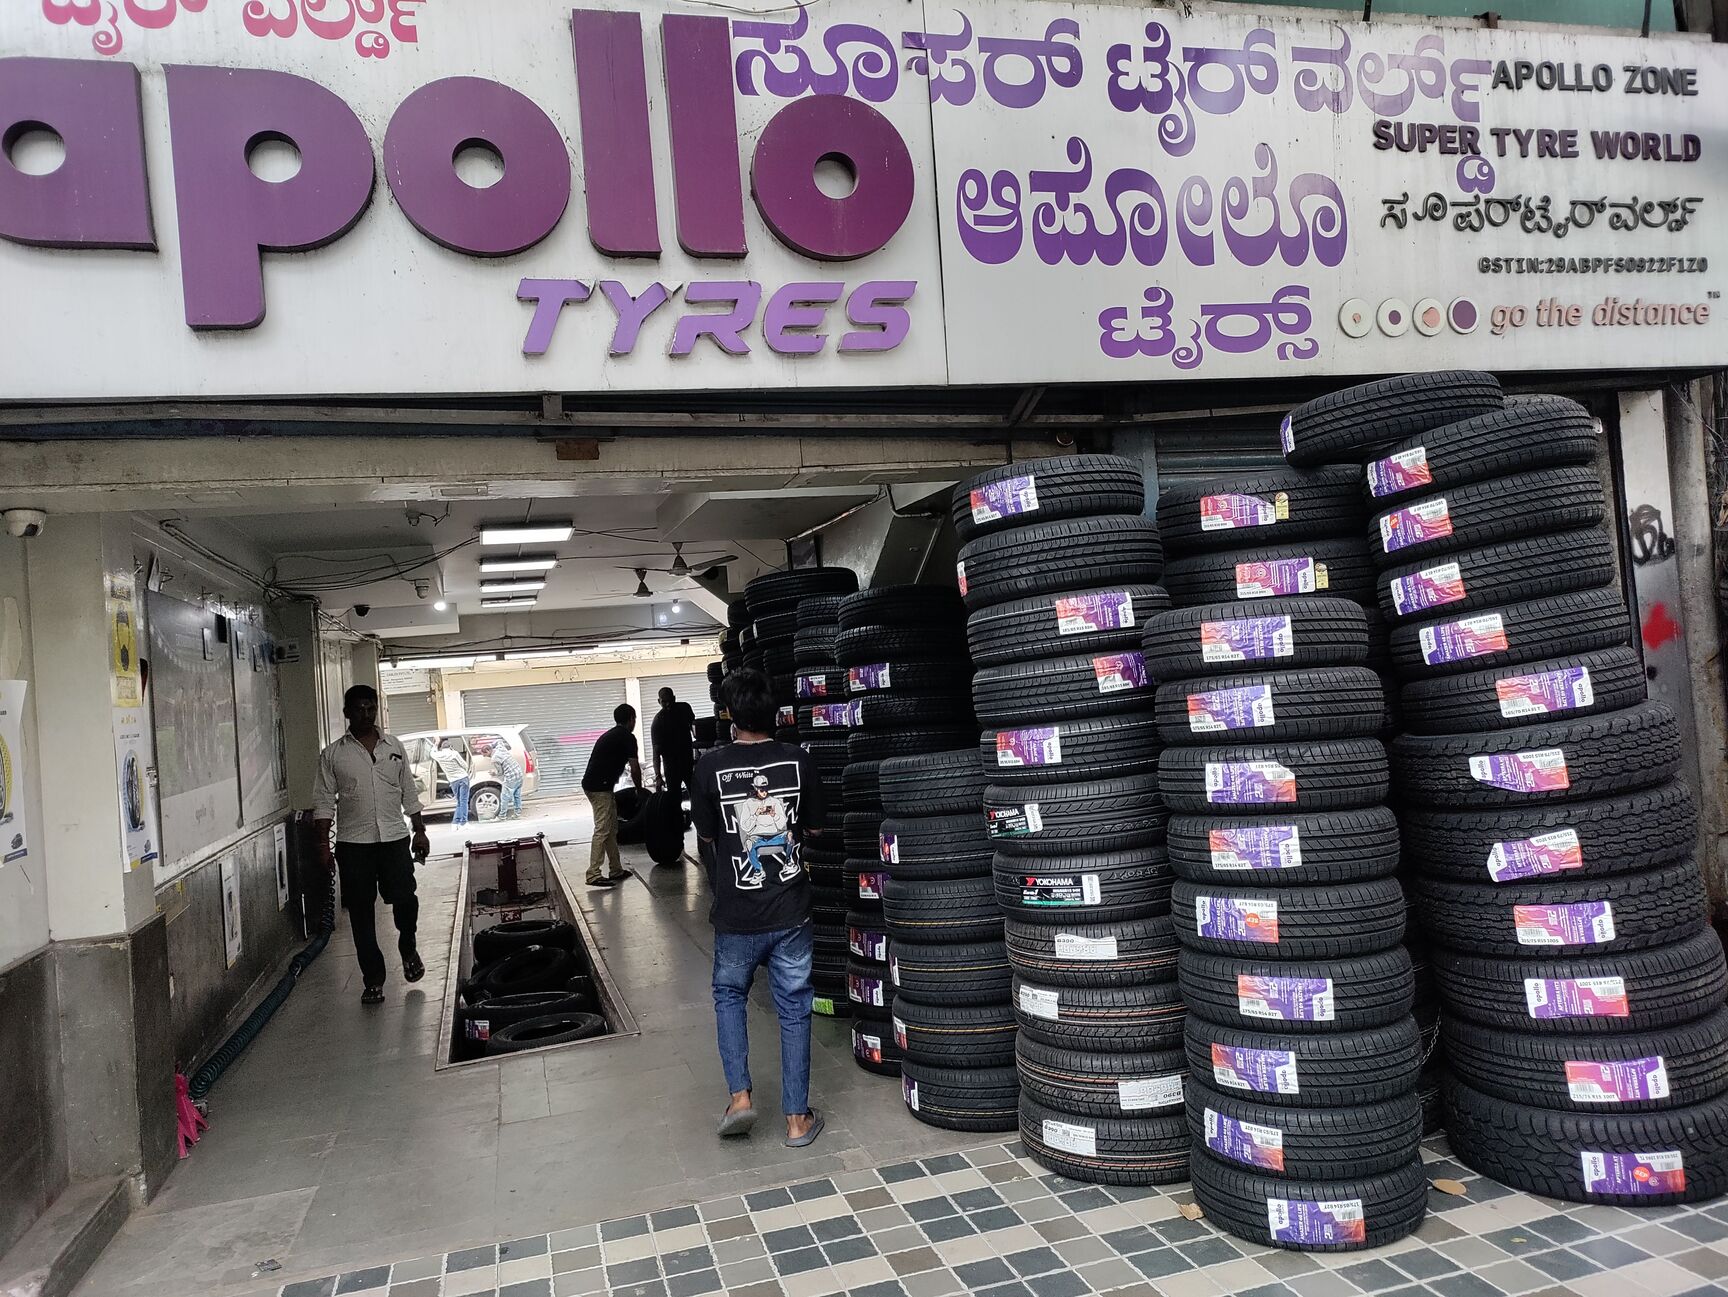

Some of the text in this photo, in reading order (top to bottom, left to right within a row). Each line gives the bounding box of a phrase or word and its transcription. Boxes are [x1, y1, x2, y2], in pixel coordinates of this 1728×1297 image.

[733, 6, 1084, 109] ಸೂಪರ್
[1106, 21, 1280, 157] ಟೈರ್
[1491, 60, 1699, 96] APOLLO ZONE
[1373, 119, 1702, 162] SUPER TYRE WORLD
[0, 9, 915, 331] apollo
[517, 278, 918, 357] TYRES
[1490, 303, 1529, 335] go
[1535, 297, 1585, 327] the
[1591, 296, 1712, 328] distance
[1257, 703, 1265, 722] apollo
[722, 771, 754, 782] Off White
[1493, 847, 1501, 866] apollo
[1036, 878, 1074, 886] YOKOHAMA
[1598, 919, 1606, 938] apollo
[1534, 983, 1542, 1002] apollo
[1280, 1070, 1288, 1090] apollo
[1652, 1075, 1660, 1094] apollo
